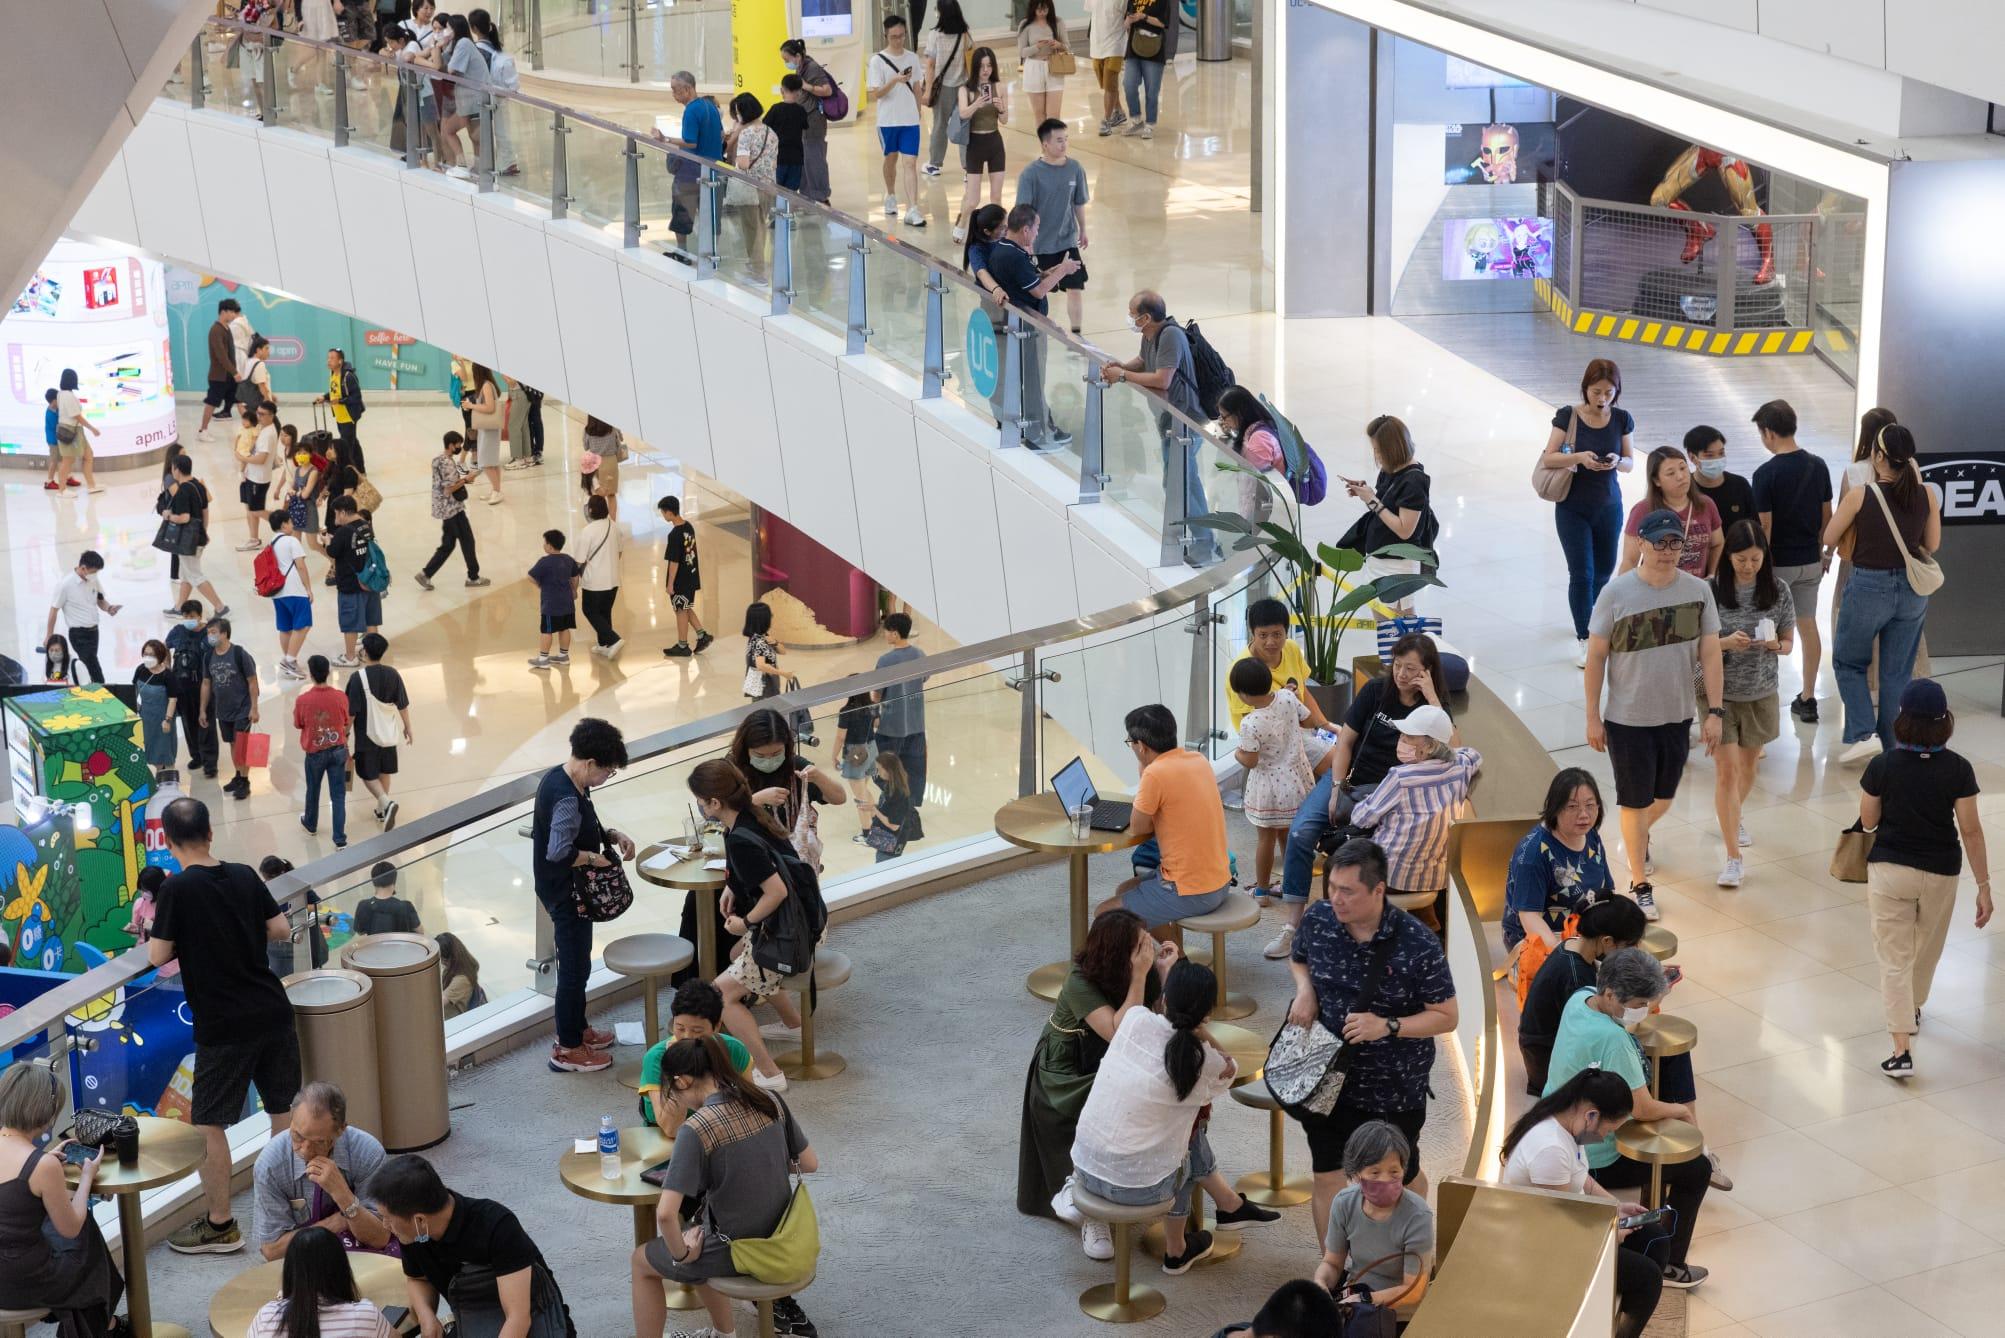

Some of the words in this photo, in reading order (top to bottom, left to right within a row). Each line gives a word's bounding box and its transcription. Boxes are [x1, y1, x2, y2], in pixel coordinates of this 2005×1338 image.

[375, 358, 397, 369] HAVE
[400, 362, 418, 371] FUN
[971, 327, 993, 378] UC
